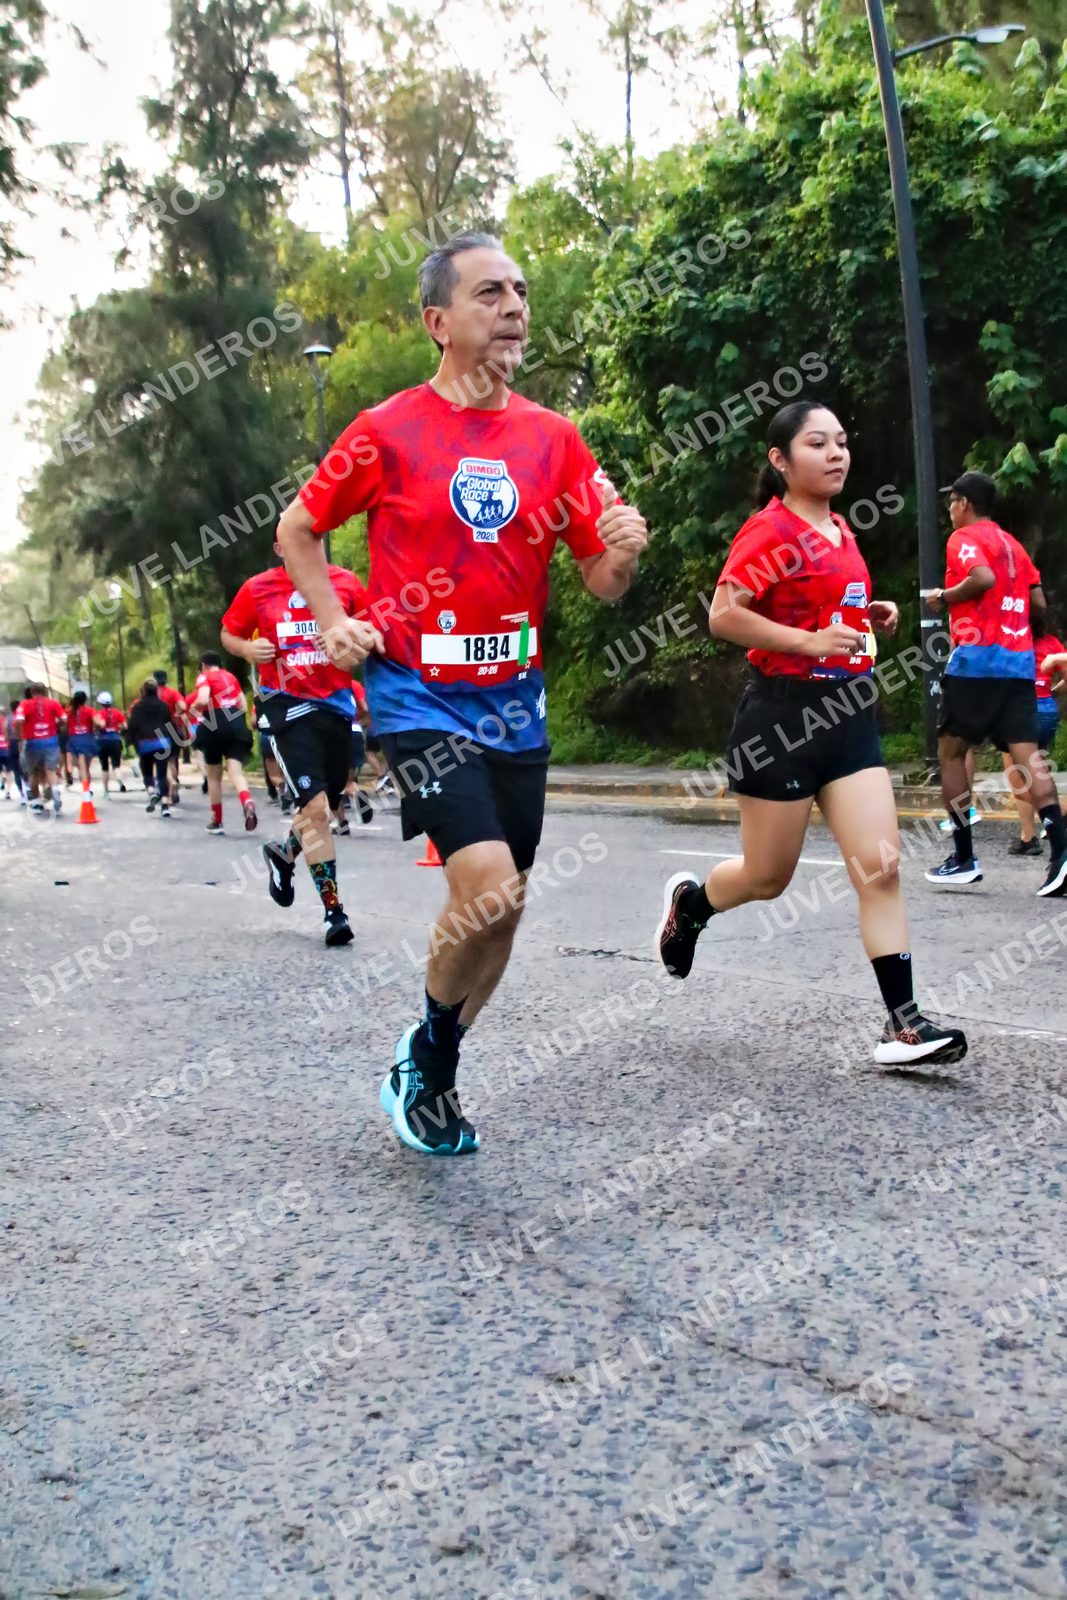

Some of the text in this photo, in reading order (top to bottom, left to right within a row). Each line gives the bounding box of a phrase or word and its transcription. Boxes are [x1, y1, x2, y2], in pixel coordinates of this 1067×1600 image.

[466, 465, 500, 475] BIMBO
[467, 477, 500, 492] Global
[460, 487, 489, 501] Race
[463, 635, 510, 662] 1834
